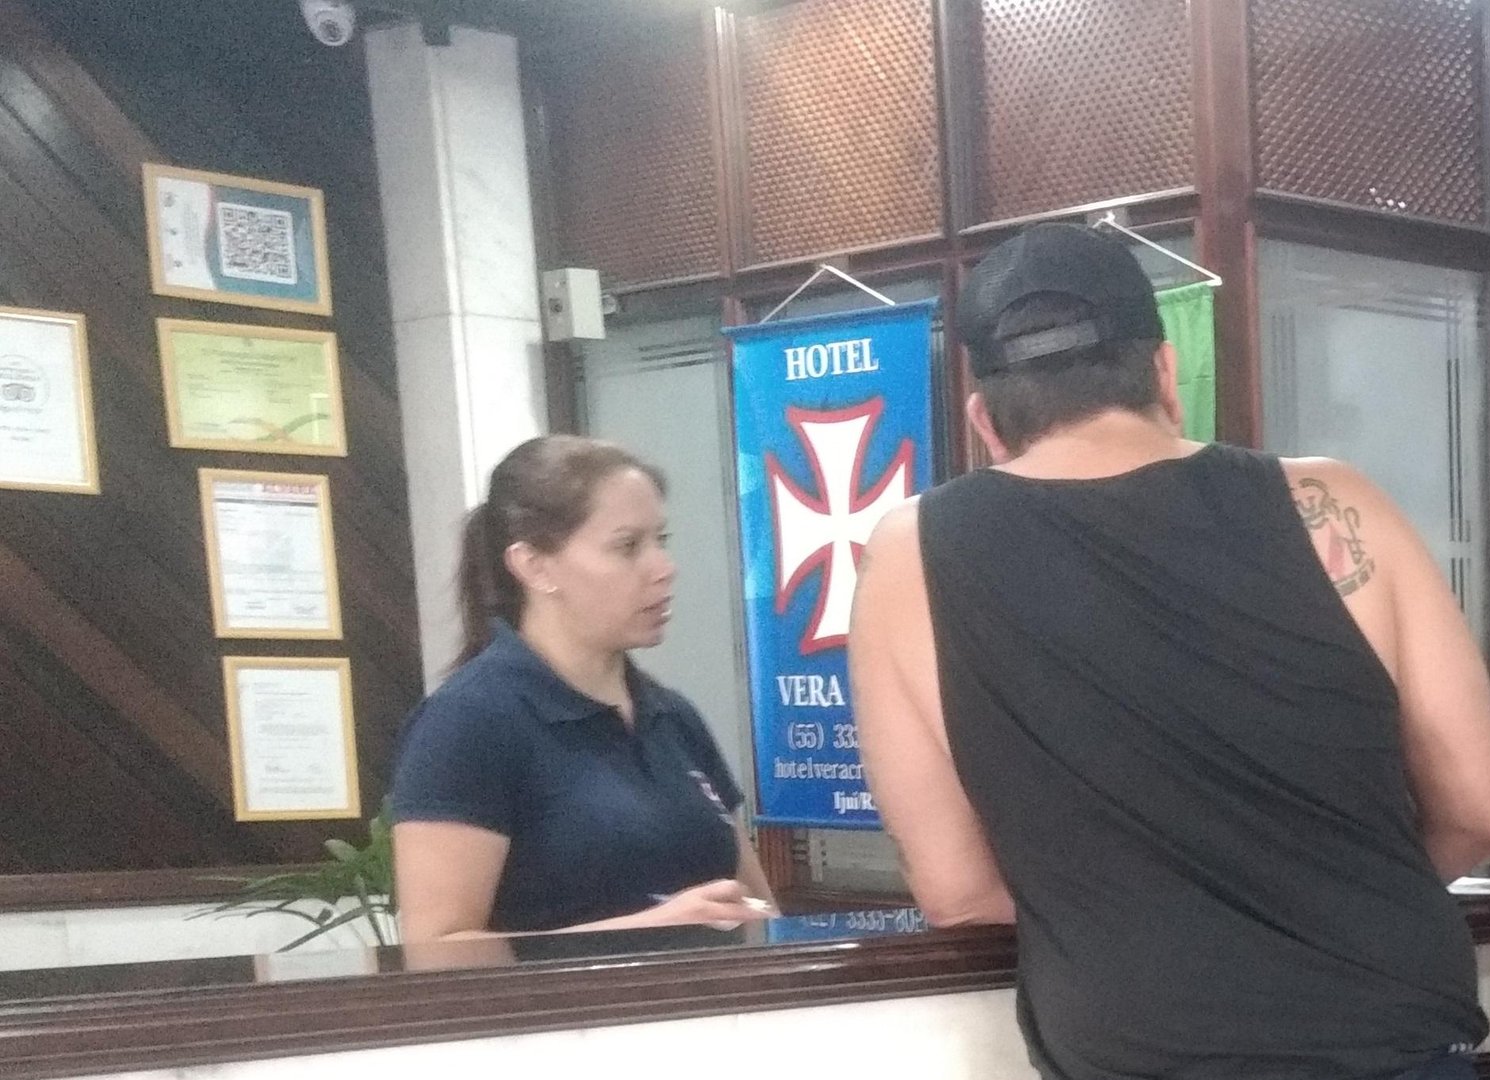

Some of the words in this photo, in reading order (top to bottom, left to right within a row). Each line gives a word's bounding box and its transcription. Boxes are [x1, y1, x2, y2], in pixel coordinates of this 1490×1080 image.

[784, 338, 879, 380] HOTEL
[776, 674, 846, 707] VERA
[787, 721, 824, 750] (55)
